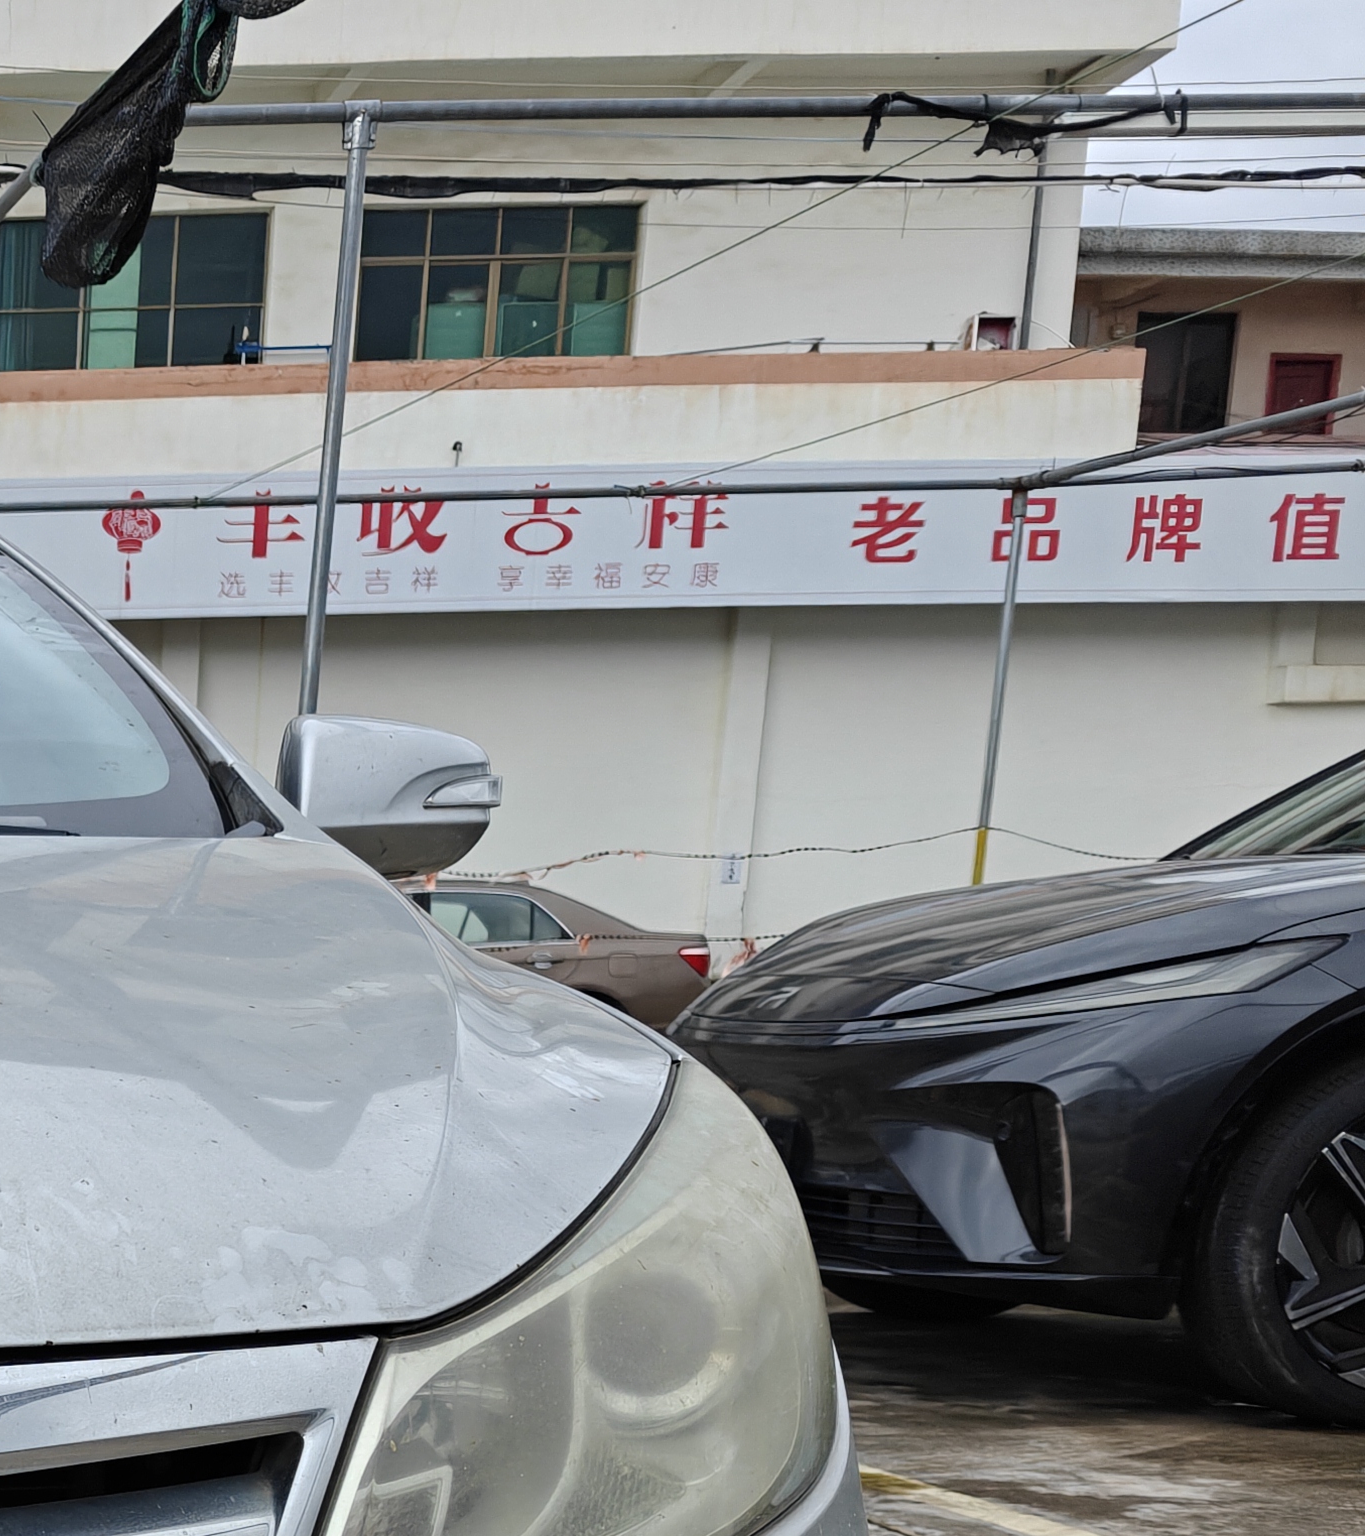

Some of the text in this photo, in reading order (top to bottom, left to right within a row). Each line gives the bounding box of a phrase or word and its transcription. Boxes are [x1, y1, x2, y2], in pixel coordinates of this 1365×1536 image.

[849, 493, 1347, 564] 老品牌值
[497, 561, 720, 592] 享幸福安康
